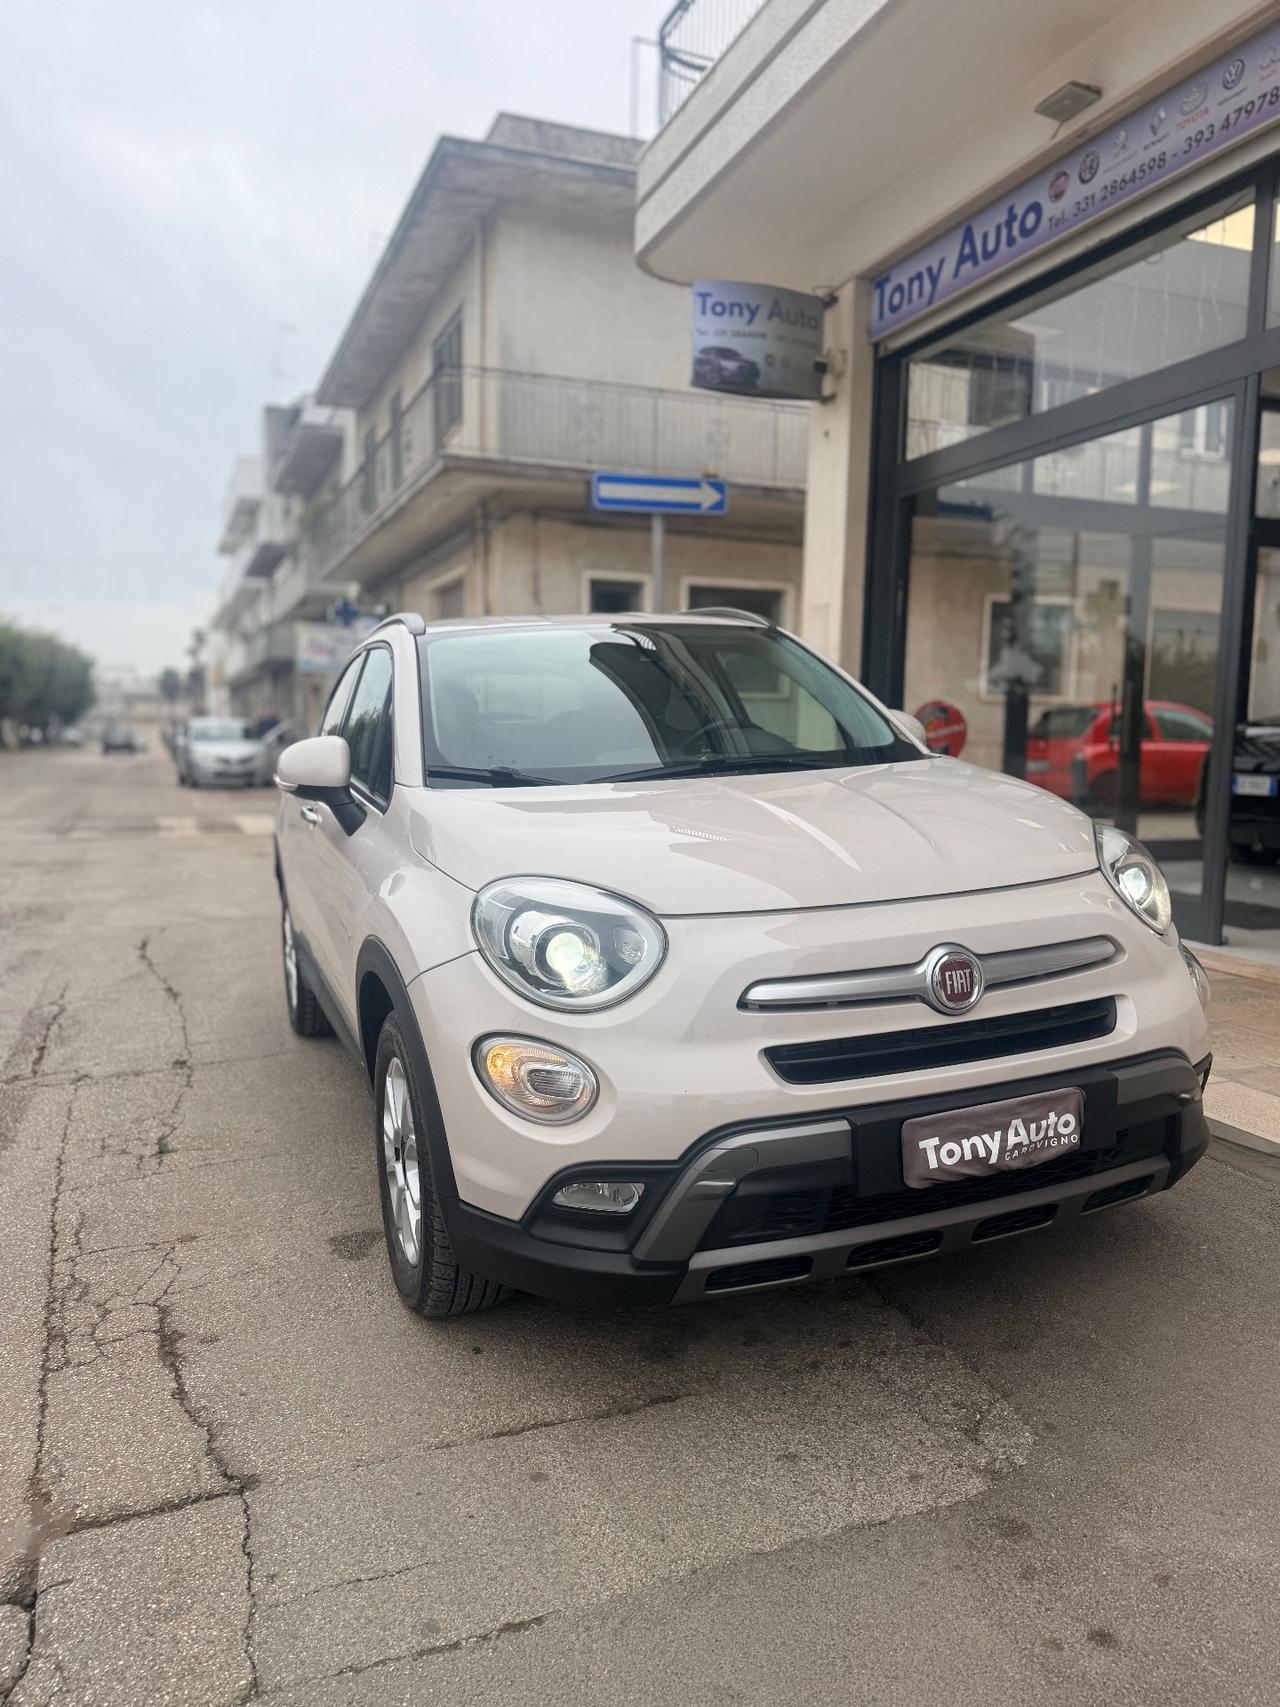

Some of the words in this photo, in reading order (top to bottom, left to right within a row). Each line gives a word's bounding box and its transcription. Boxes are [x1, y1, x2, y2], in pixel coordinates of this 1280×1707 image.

[1048, 208, 1069, 230] Tel.
[1073, 192, 1096, 218] 331
[1101, 151, 1168, 201] 2864598
[1182, 123, 1215, 155] 393
[874, 255, 946, 321] Tony
[953, 201, 1043, 279] Auto
[697, 293, 760, 326] Tony
[768, 298, 819, 331] Auto
[945, 969, 971, 994] FIAT
[919, 1130, 1001, 1169] Tony
[1006, 1111, 1076, 1151] Auto
[1004, 1134, 1078, 1161] CAROVIGNO
